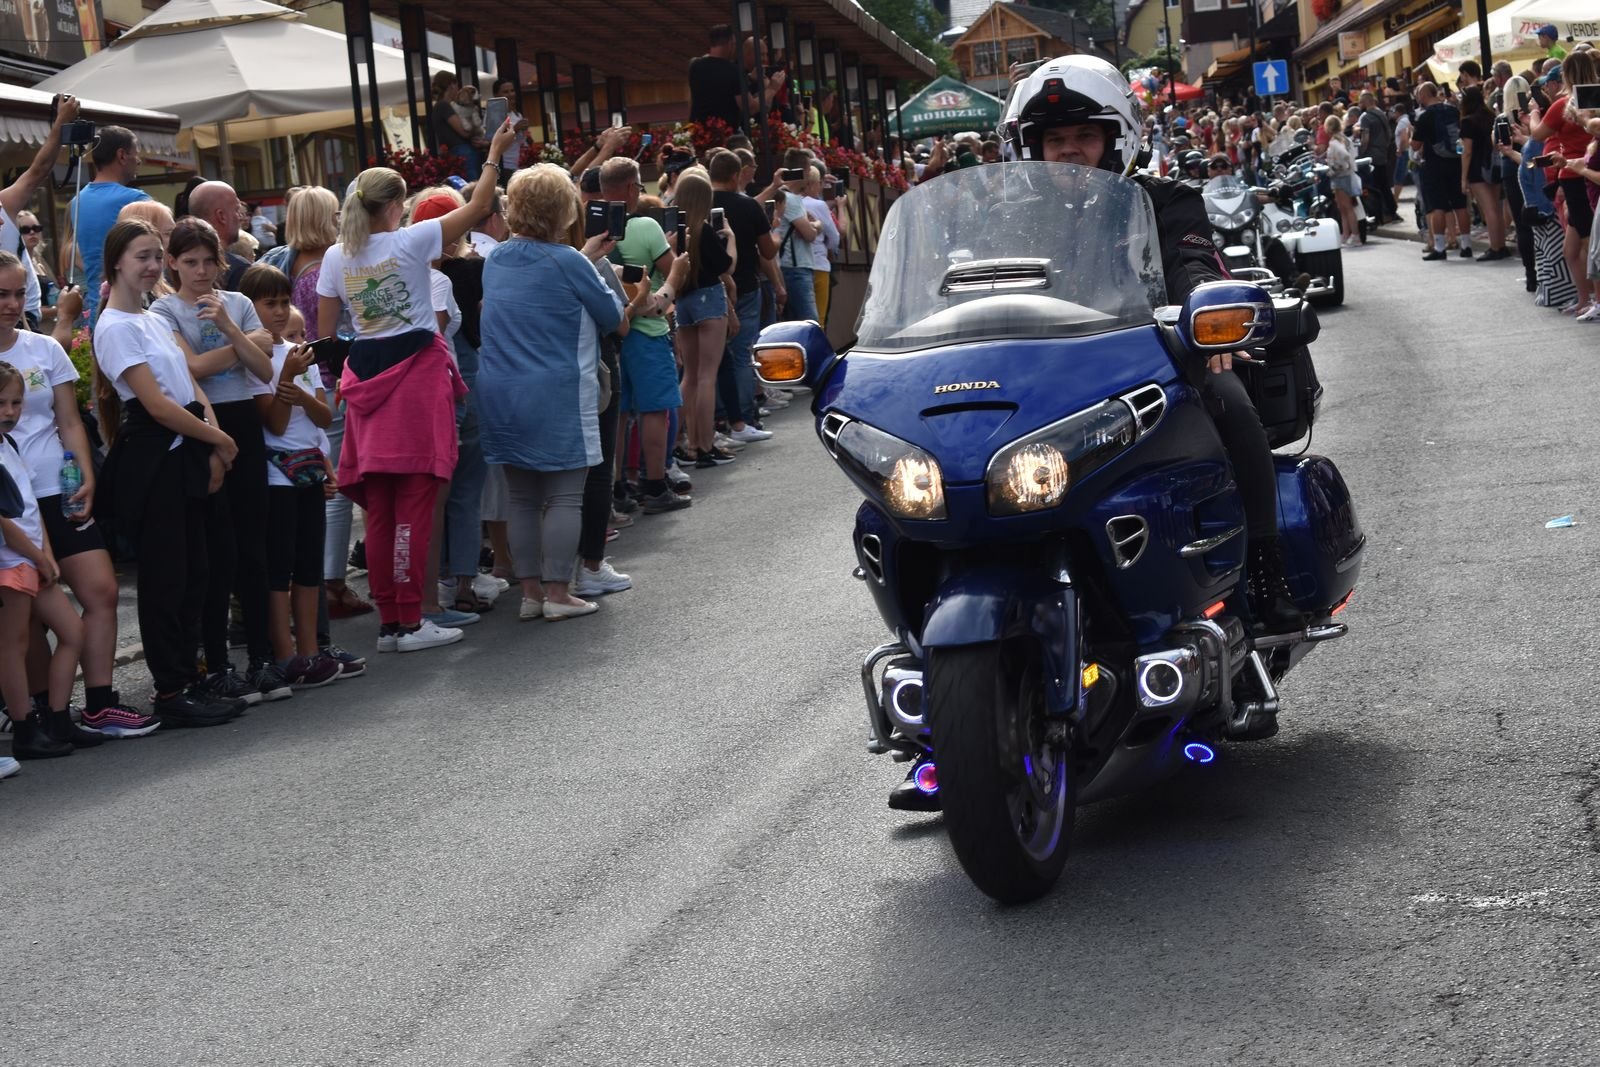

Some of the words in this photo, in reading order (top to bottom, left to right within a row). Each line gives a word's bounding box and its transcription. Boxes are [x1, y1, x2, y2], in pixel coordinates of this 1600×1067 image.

[1566, 23, 1599, 37] VERDE
[911, 108, 988, 122] ROHOZEC
[343, 257, 400, 279] SUMMER
[354, 287, 391, 301] DANCE
[394, 281, 410, 302] 3
[934, 381, 1000, 394] HONDA
